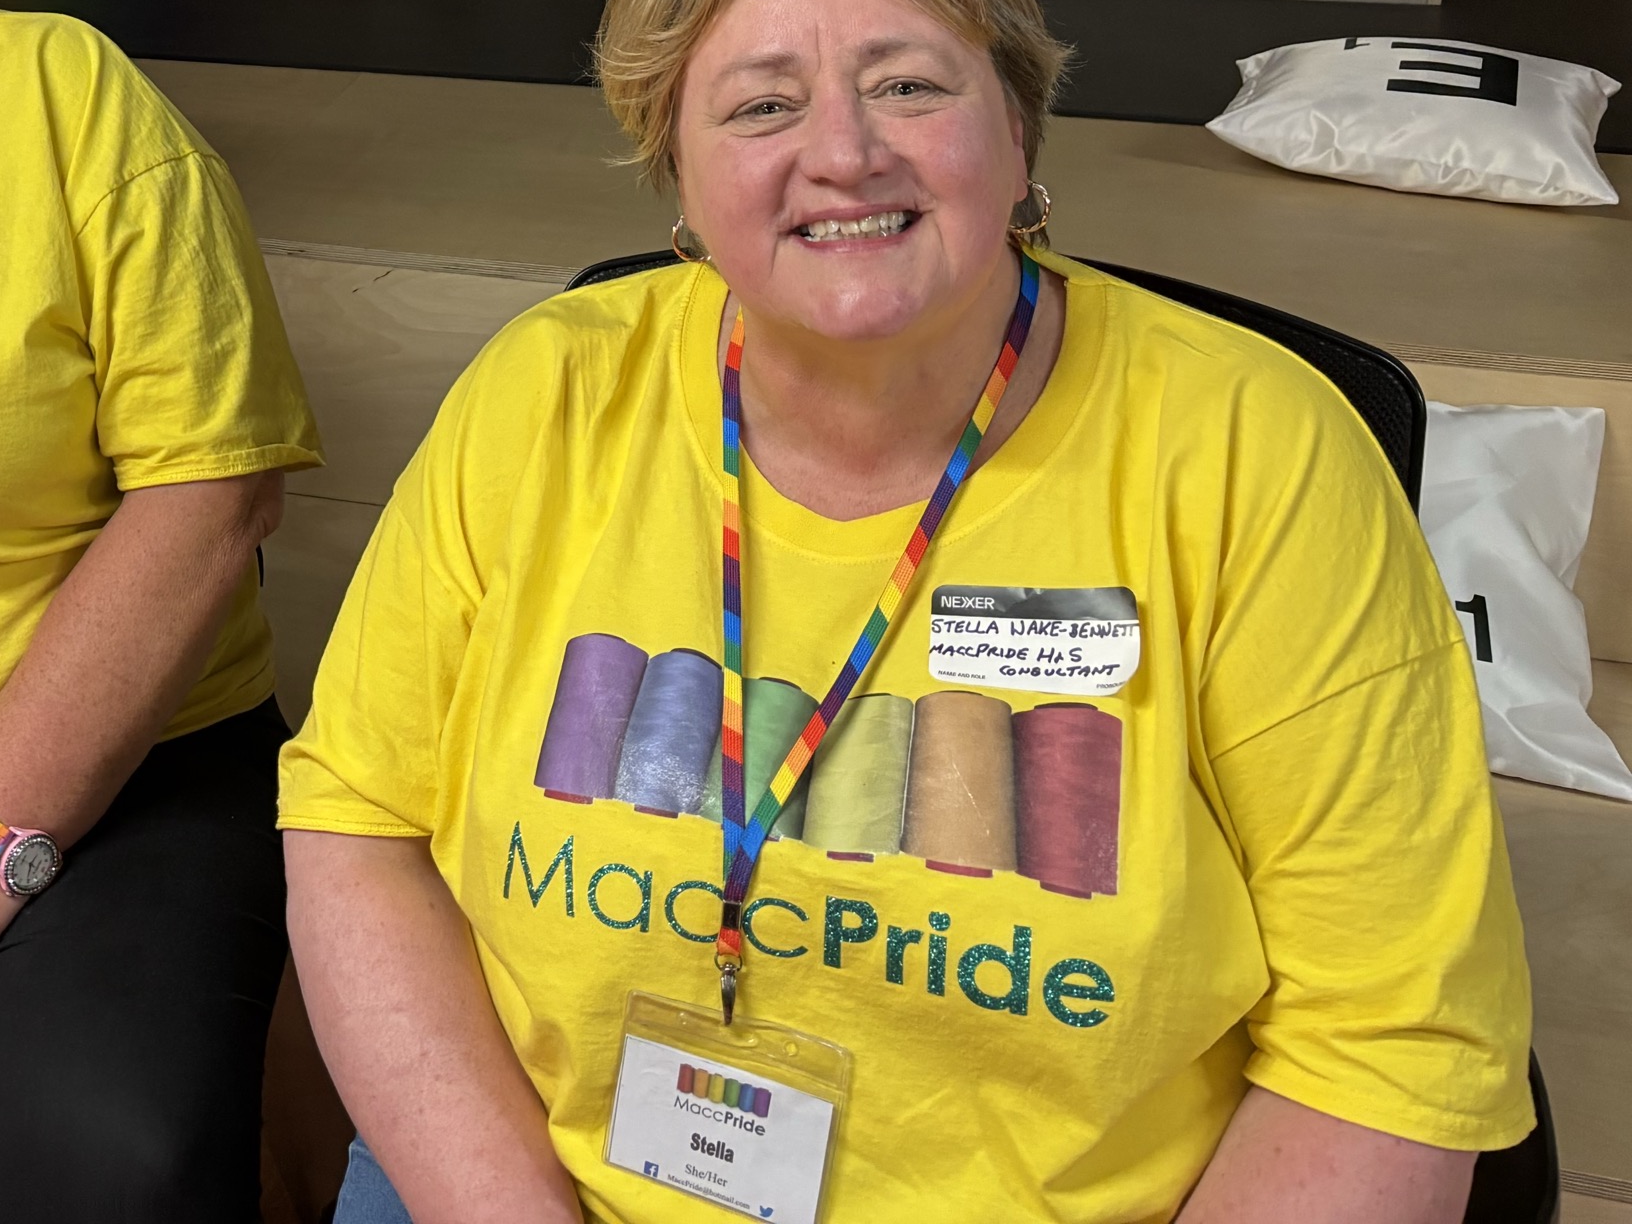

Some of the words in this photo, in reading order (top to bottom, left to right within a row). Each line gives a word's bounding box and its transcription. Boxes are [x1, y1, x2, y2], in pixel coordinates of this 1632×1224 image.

[931, 618, 1000, 635] STELLA
[502, 820, 1117, 1028] MaccPride
[673, 1094, 767, 1137] MaccPride
[689, 1131, 735, 1164] Stella
[684, 1163, 728, 1189] She/Her
